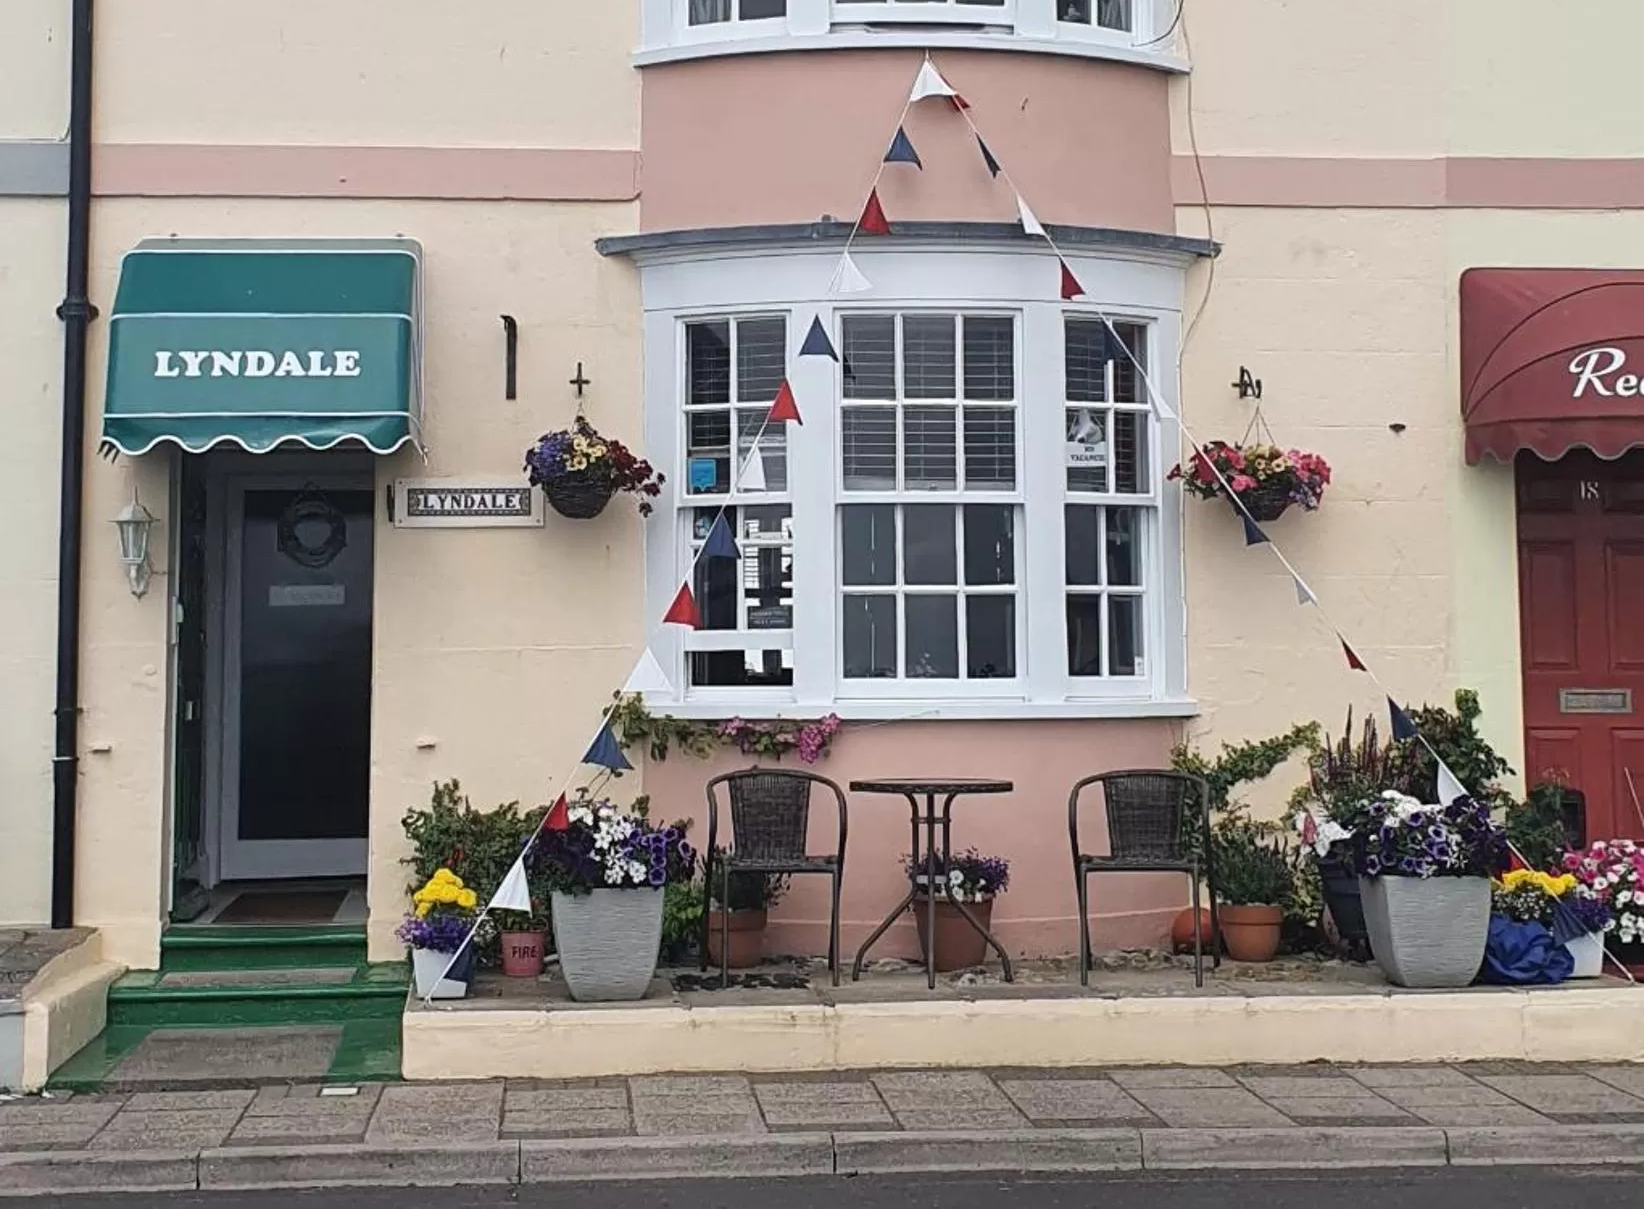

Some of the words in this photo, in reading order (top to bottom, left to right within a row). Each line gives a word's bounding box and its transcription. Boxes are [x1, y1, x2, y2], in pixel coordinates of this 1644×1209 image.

[154, 350, 361, 377] LYNDALE
[1568, 347, 1644, 397] Re
[1580, 480, 1599, 499] 18
[423, 494, 517, 509] LYNDALE
[511, 945, 539, 959] FIRE
